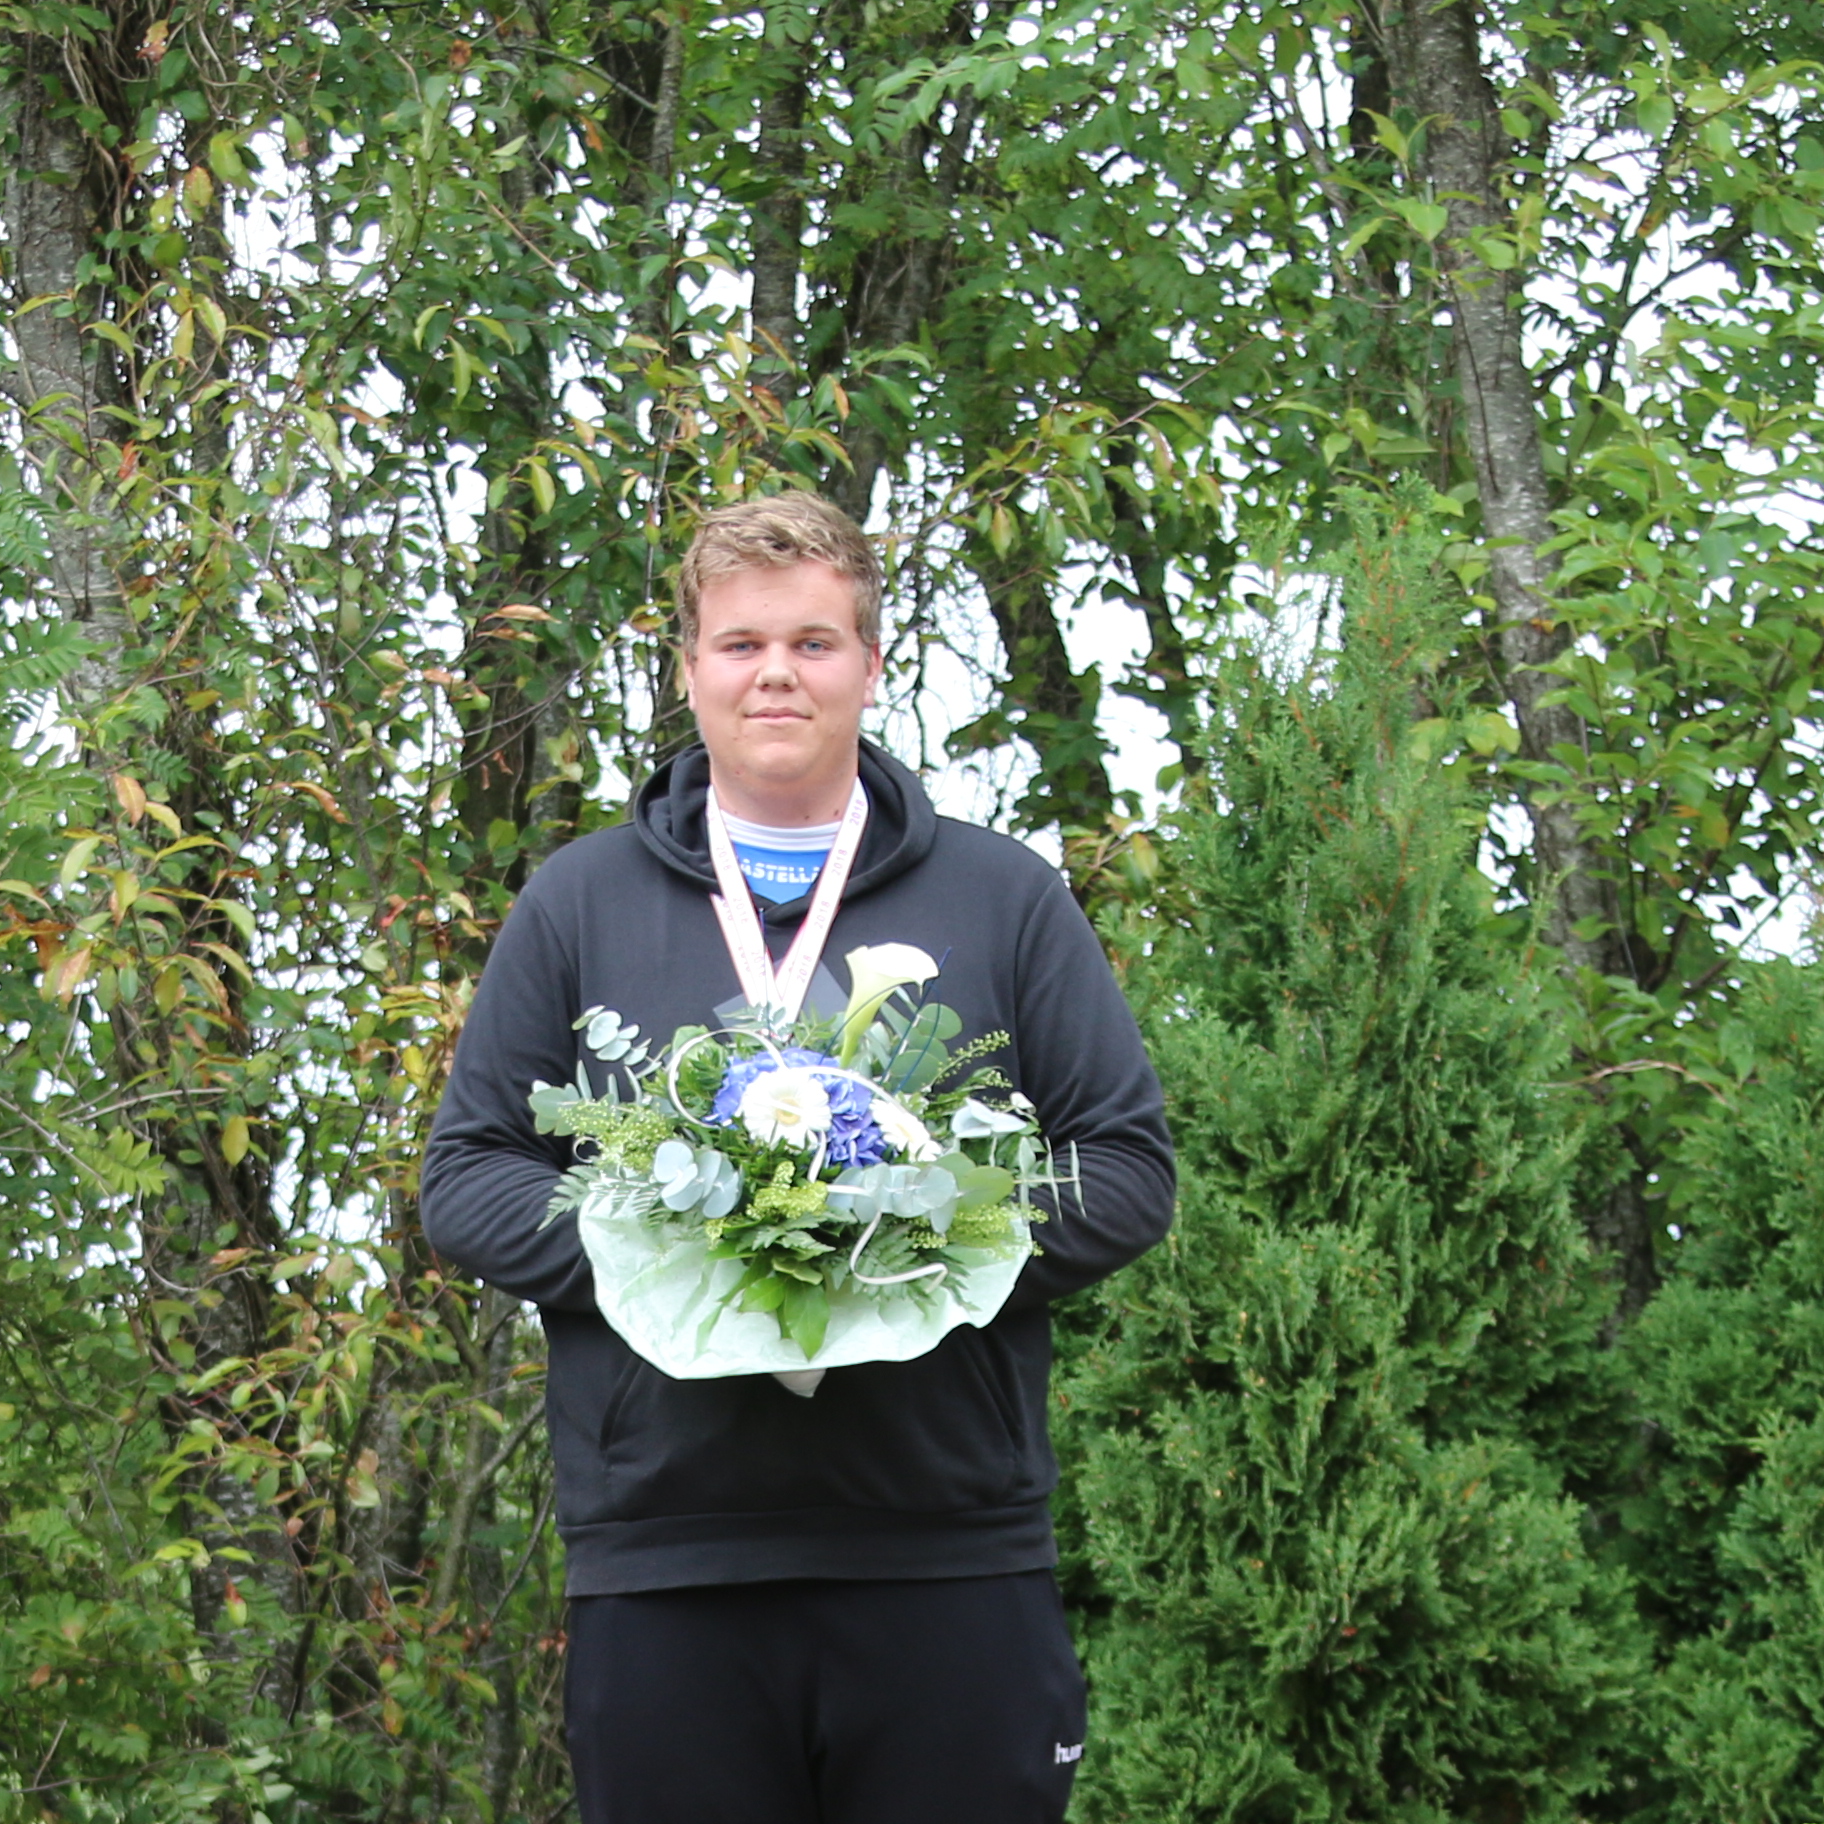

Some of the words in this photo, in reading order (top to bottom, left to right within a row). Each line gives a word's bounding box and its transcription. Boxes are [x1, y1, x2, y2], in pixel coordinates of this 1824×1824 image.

[849, 799, 865, 826] 2018
[831, 849, 848, 876] 2018
[814, 900, 831, 929] 2018
[797, 955, 813, 983] 2018
